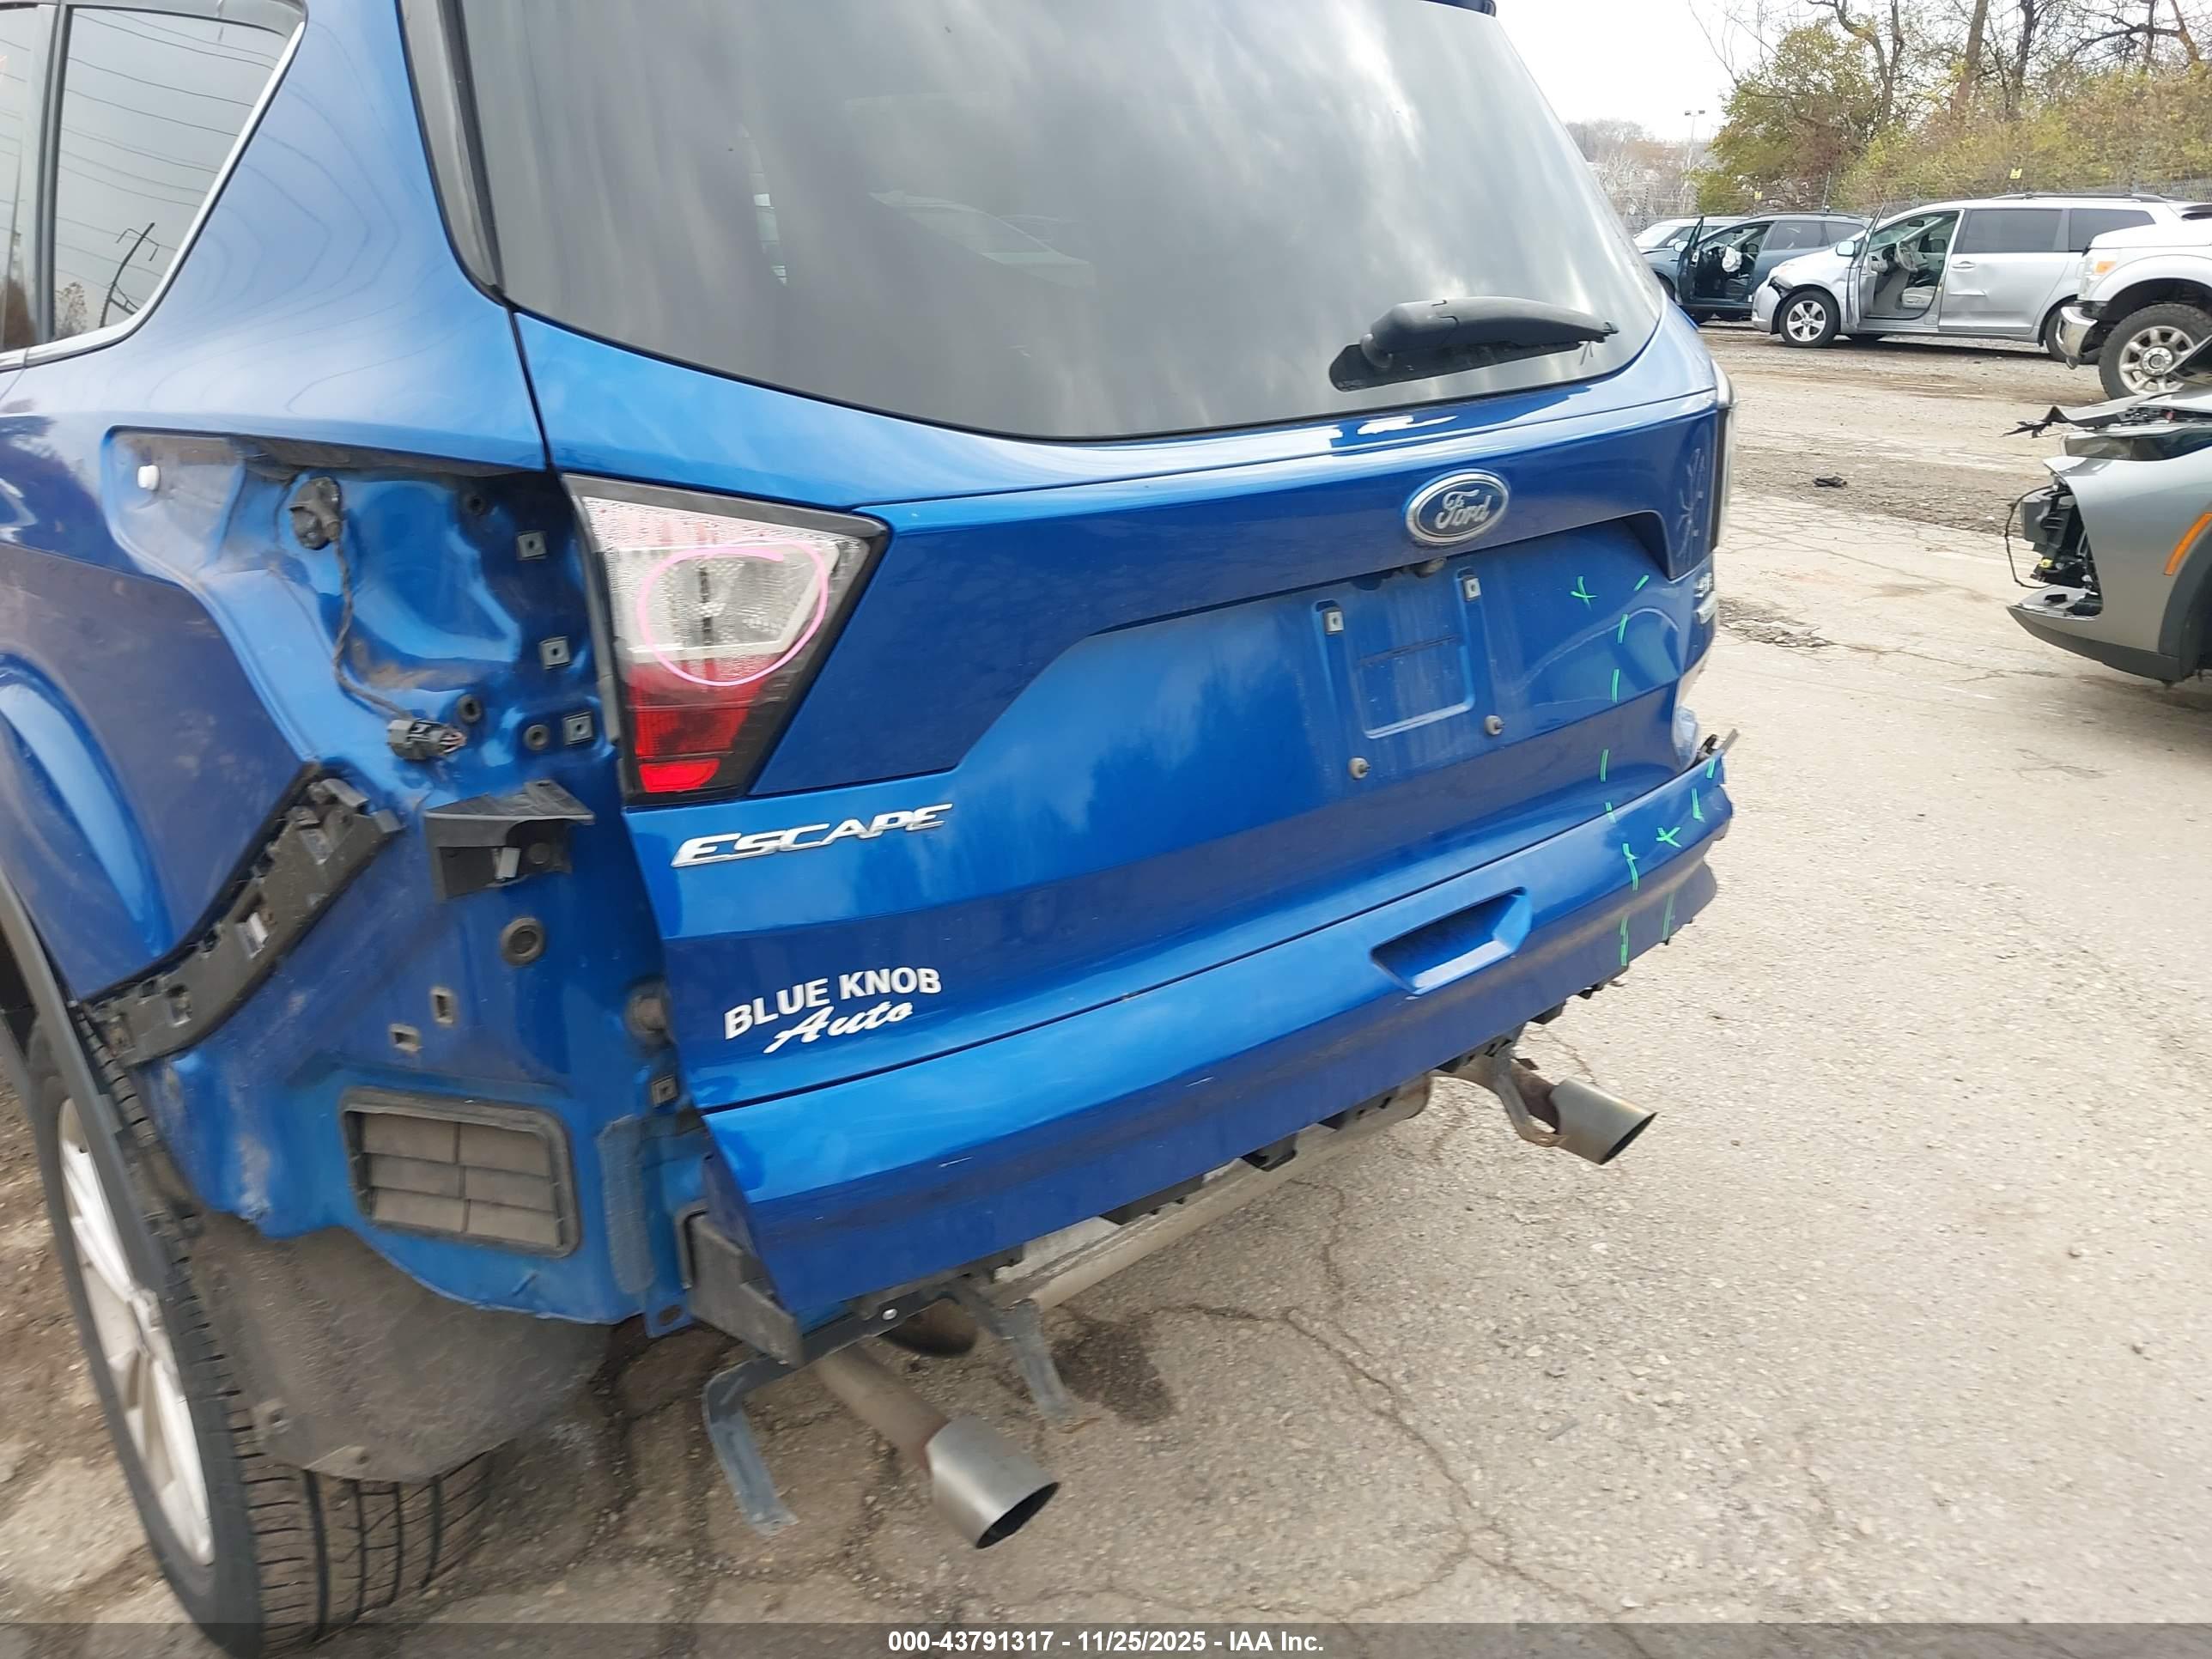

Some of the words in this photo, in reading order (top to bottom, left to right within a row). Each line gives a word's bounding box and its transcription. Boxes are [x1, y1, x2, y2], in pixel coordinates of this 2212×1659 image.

[1435, 488, 1492, 530] Ford
[670, 803, 953, 868] ESCAPE
[723, 977, 831, 1040] BLUE
[838, 967, 943, 1000] KNOB
[763, 1000, 914, 1054] Auto
